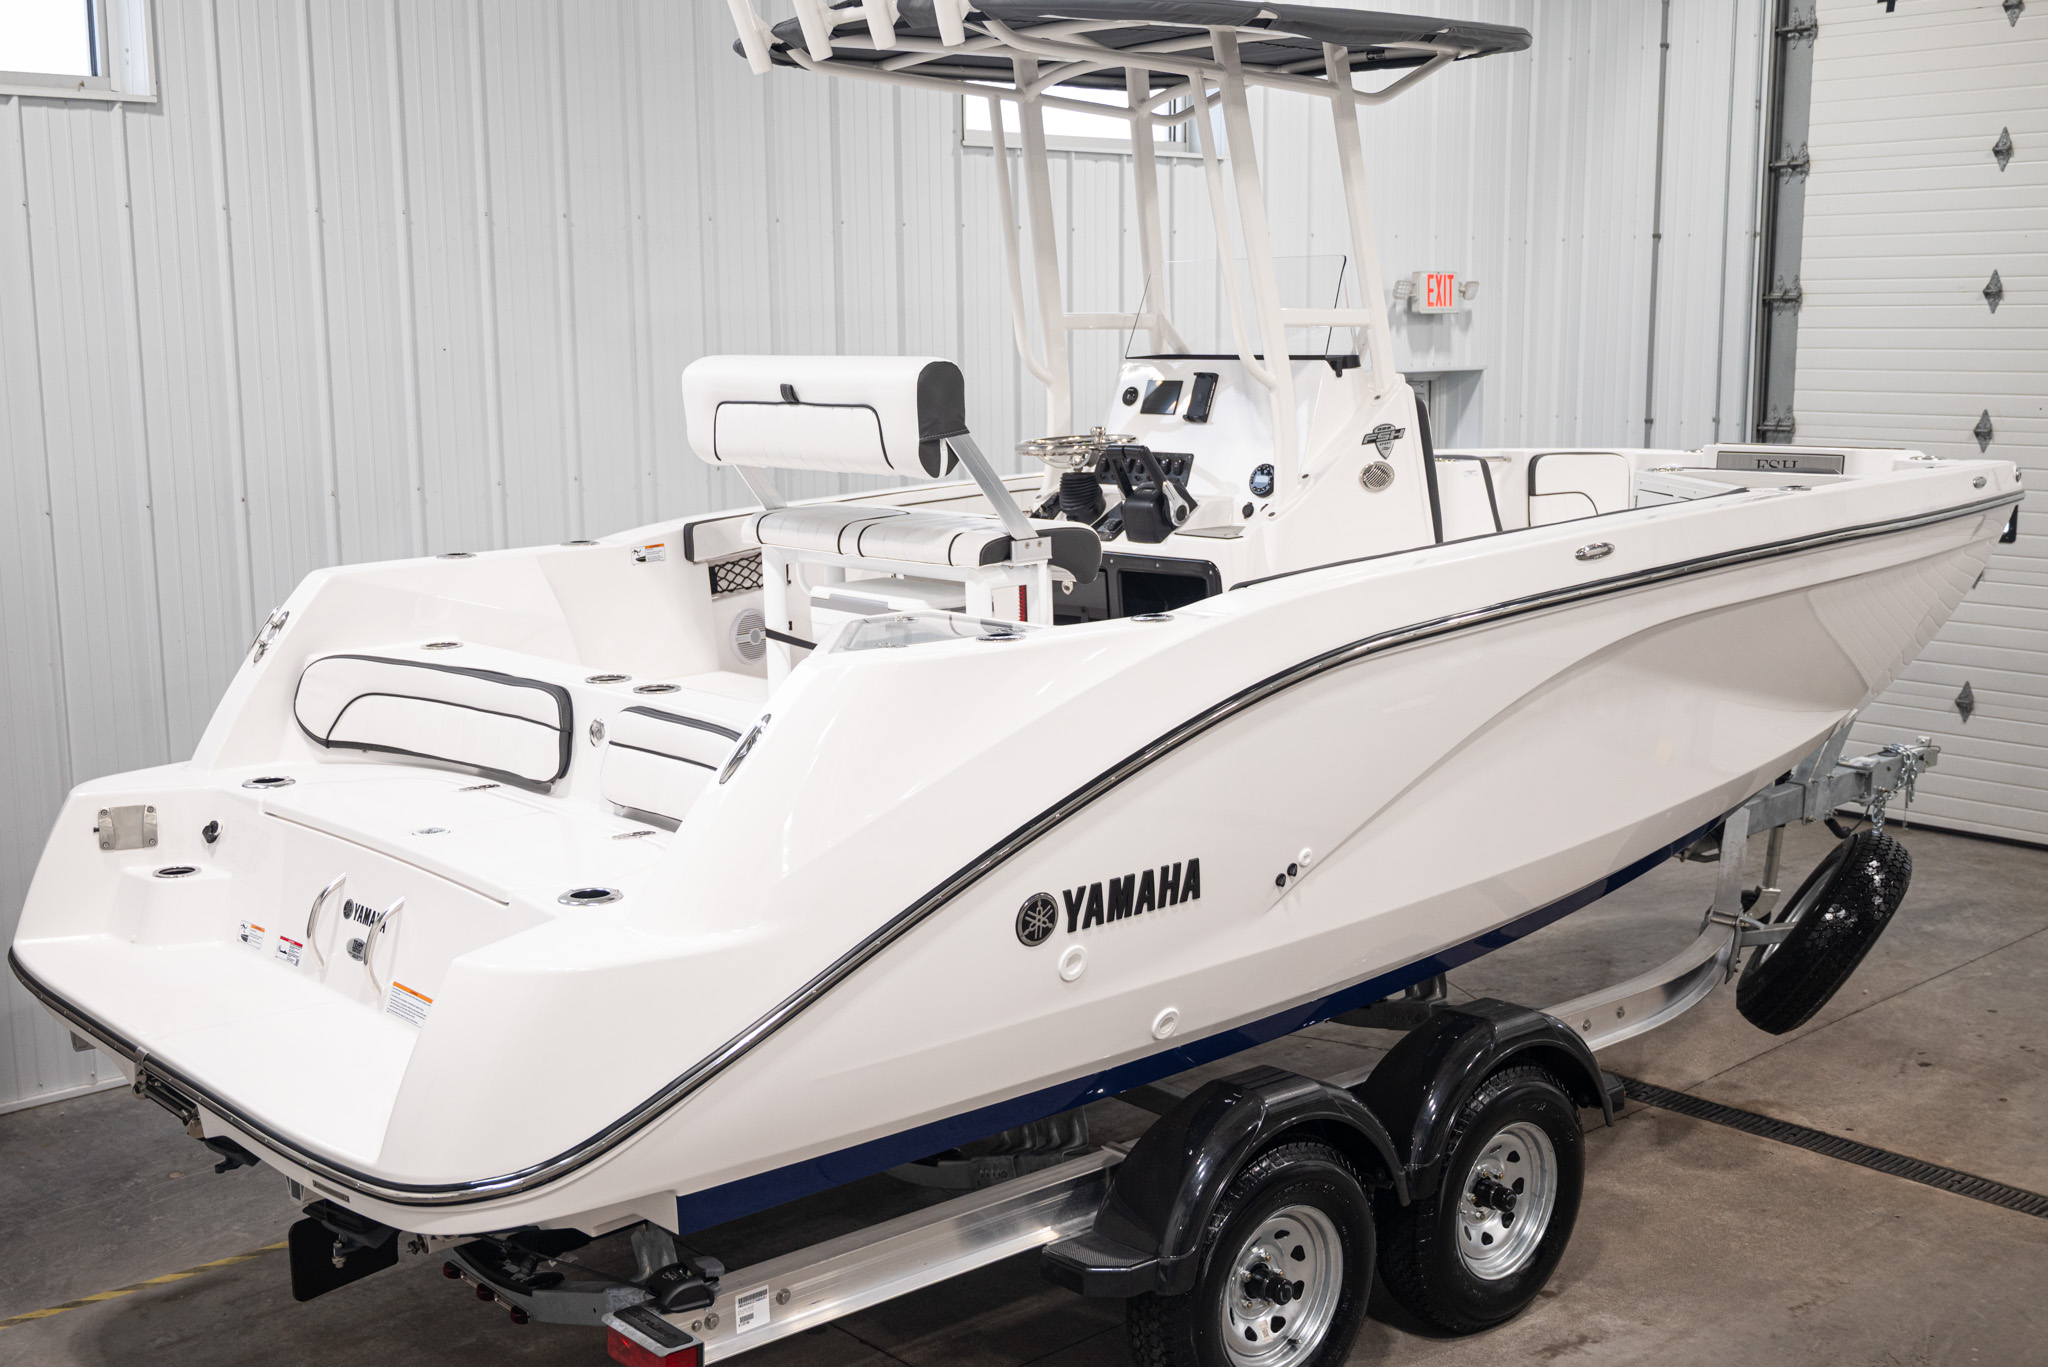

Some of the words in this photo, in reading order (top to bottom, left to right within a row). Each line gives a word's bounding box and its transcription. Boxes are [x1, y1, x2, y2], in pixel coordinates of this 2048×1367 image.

[1427, 274, 1454, 307] EXIT
[1362, 427, 1405, 445] FSH
[1062, 857, 1201, 934] YAMAHA
[353, 902, 387, 934] YAMAA
